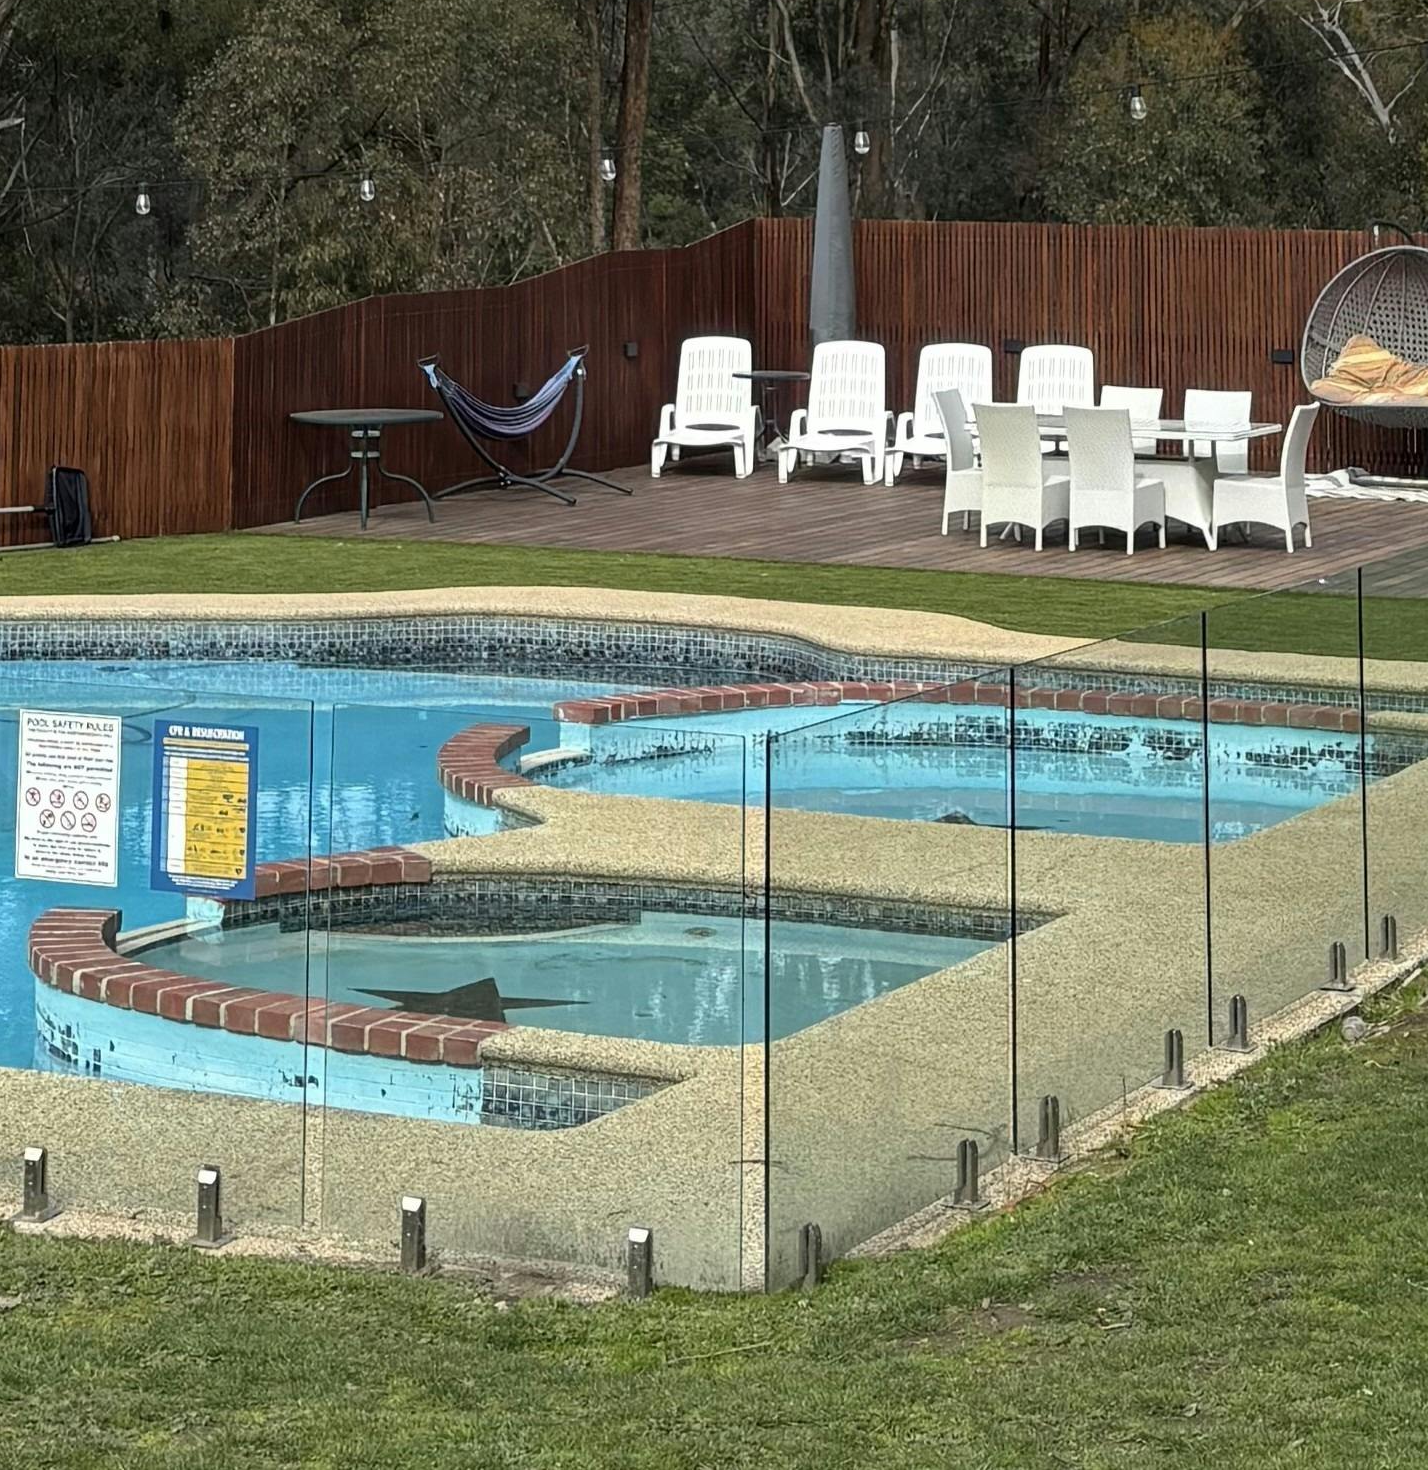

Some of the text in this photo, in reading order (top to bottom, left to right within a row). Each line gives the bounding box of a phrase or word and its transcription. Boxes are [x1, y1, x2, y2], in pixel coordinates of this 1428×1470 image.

[27, 717, 114, 732] POOL SAFETY RULES
